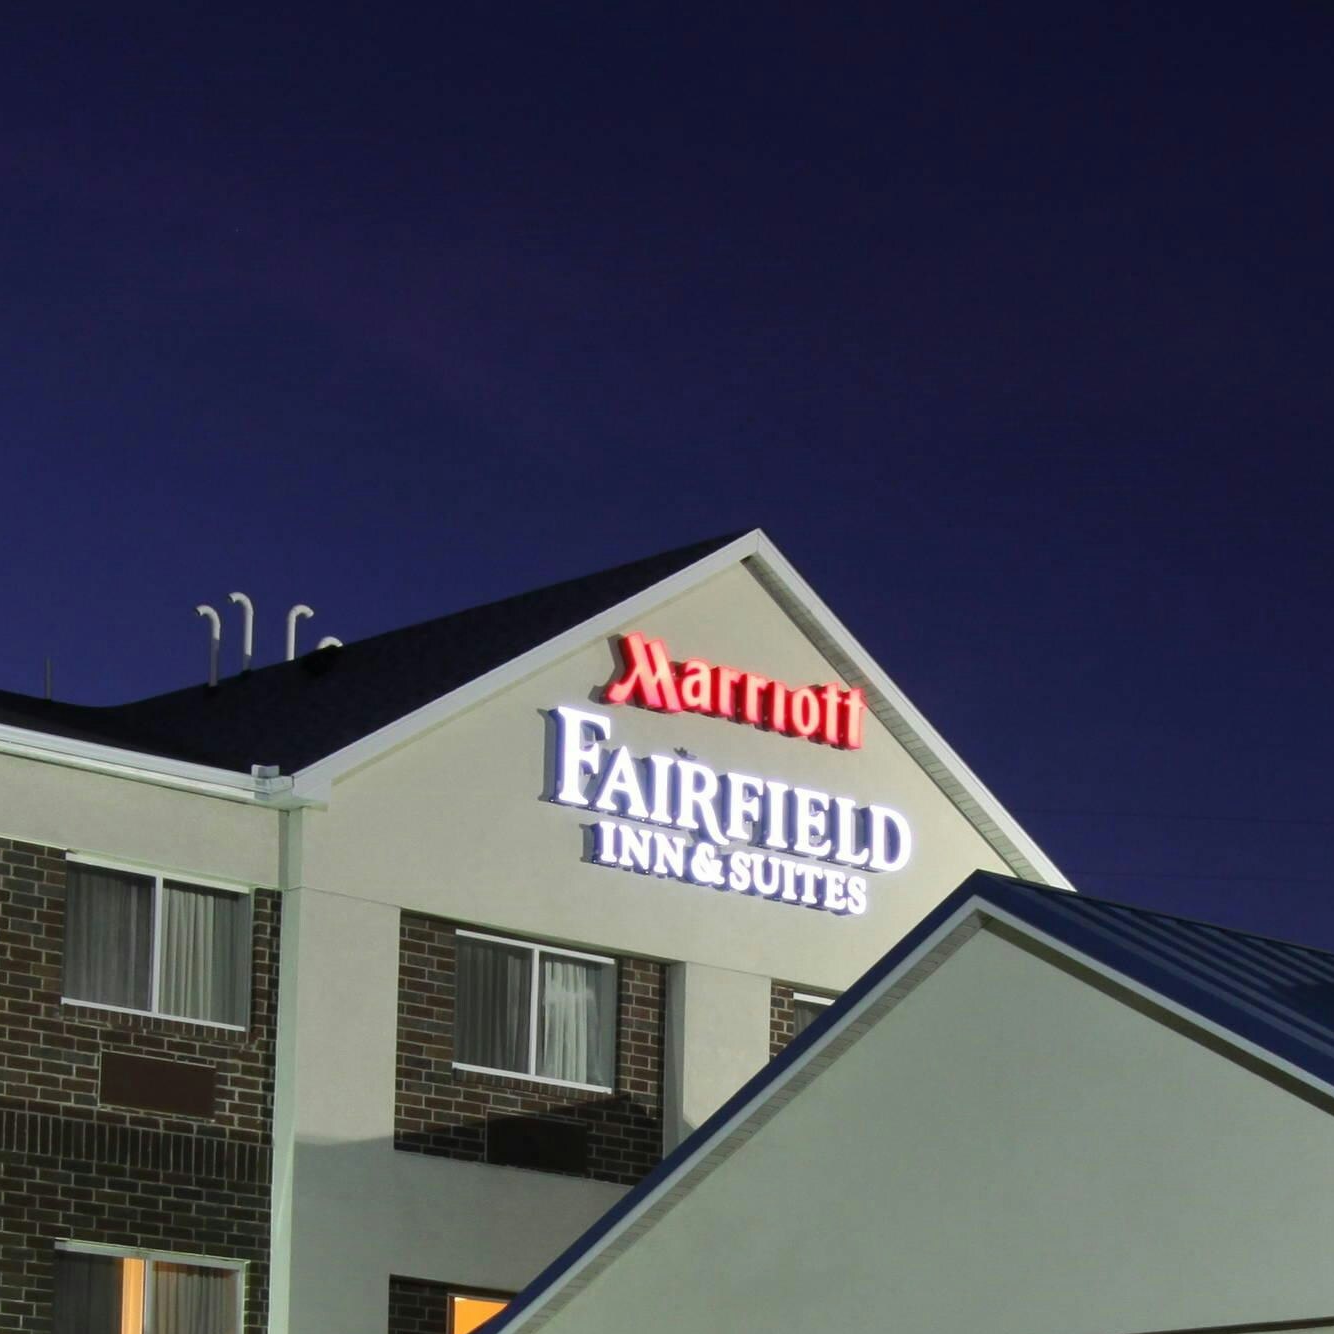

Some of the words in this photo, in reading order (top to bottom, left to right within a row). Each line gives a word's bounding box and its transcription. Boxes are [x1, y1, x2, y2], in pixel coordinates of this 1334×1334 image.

[606, 631, 868, 750] Marriott
[553, 706, 913, 873] FAIRFIELD
[595, 820, 689, 877] INN
[690, 845, 726, 886] &
[729, 850, 868, 915] SUITES
